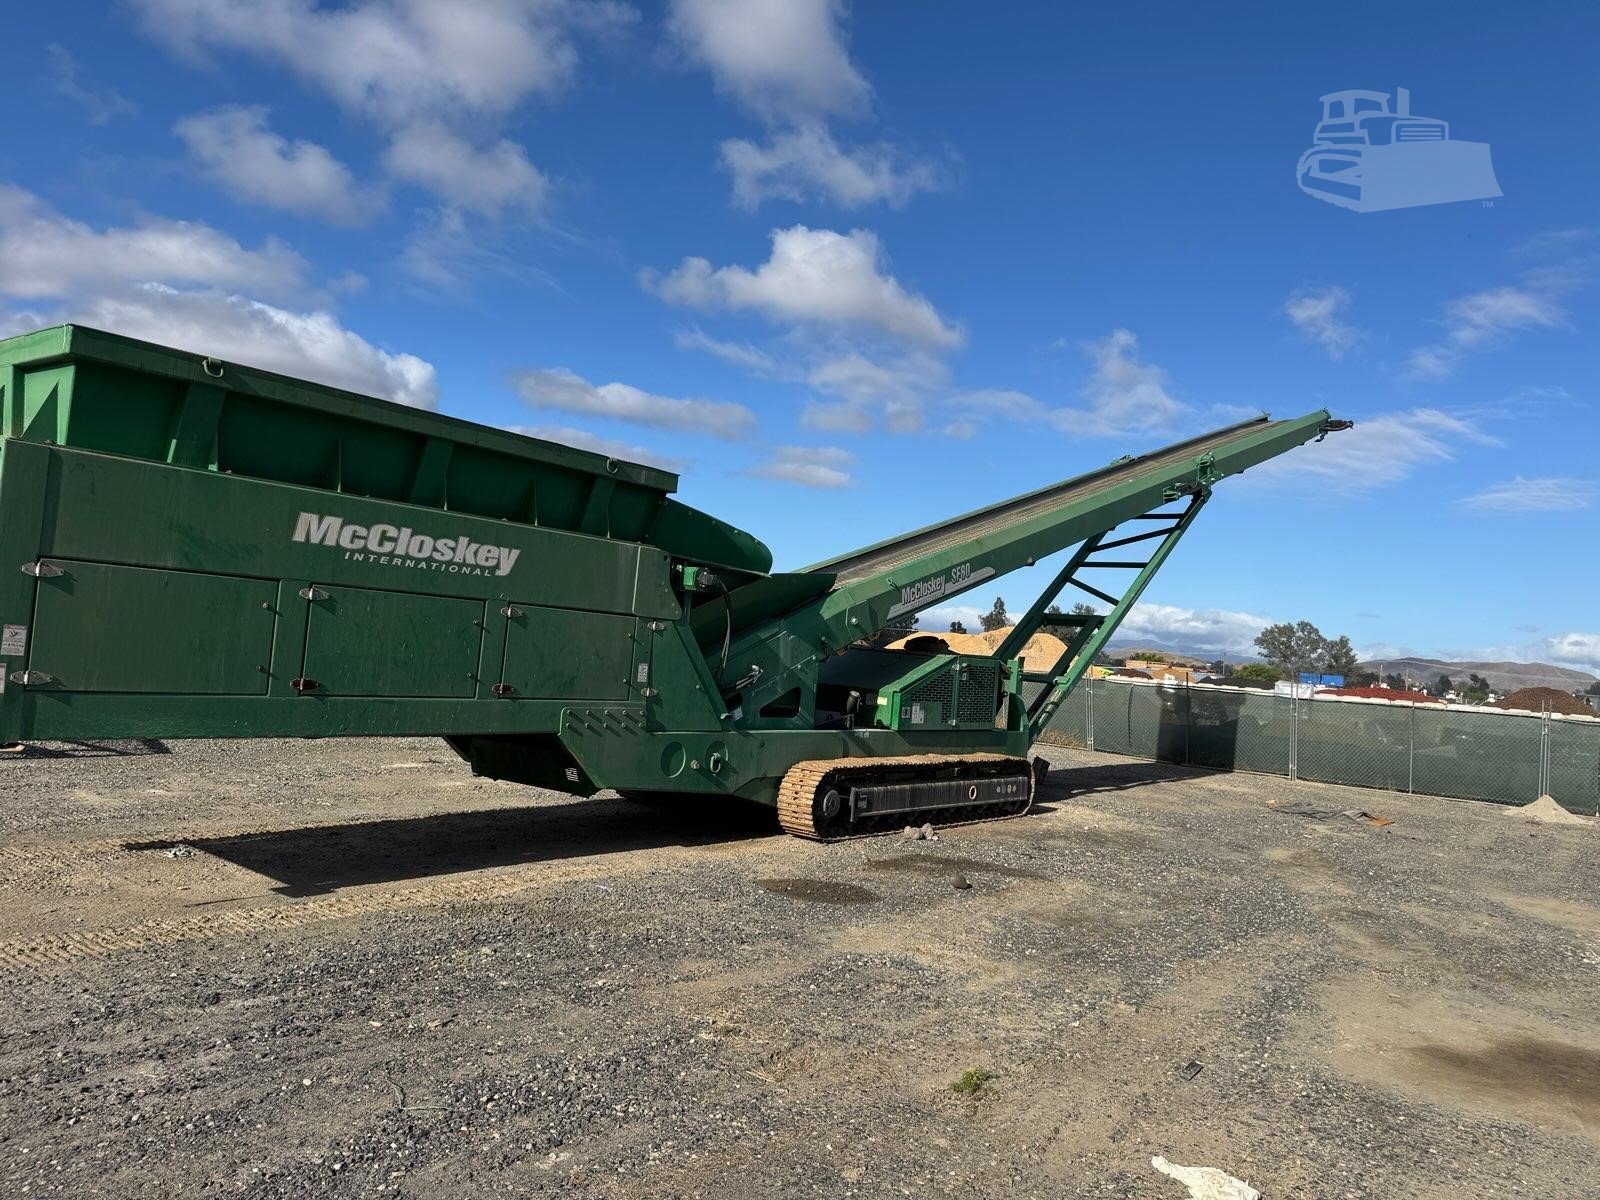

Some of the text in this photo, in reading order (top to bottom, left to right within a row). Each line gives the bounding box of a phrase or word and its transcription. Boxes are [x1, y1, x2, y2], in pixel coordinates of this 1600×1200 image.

[292, 511, 521, 577] McCloskey
[344, 551, 491, 577] INTERNATIONAL
[901, 574, 946, 605] McCloskey
